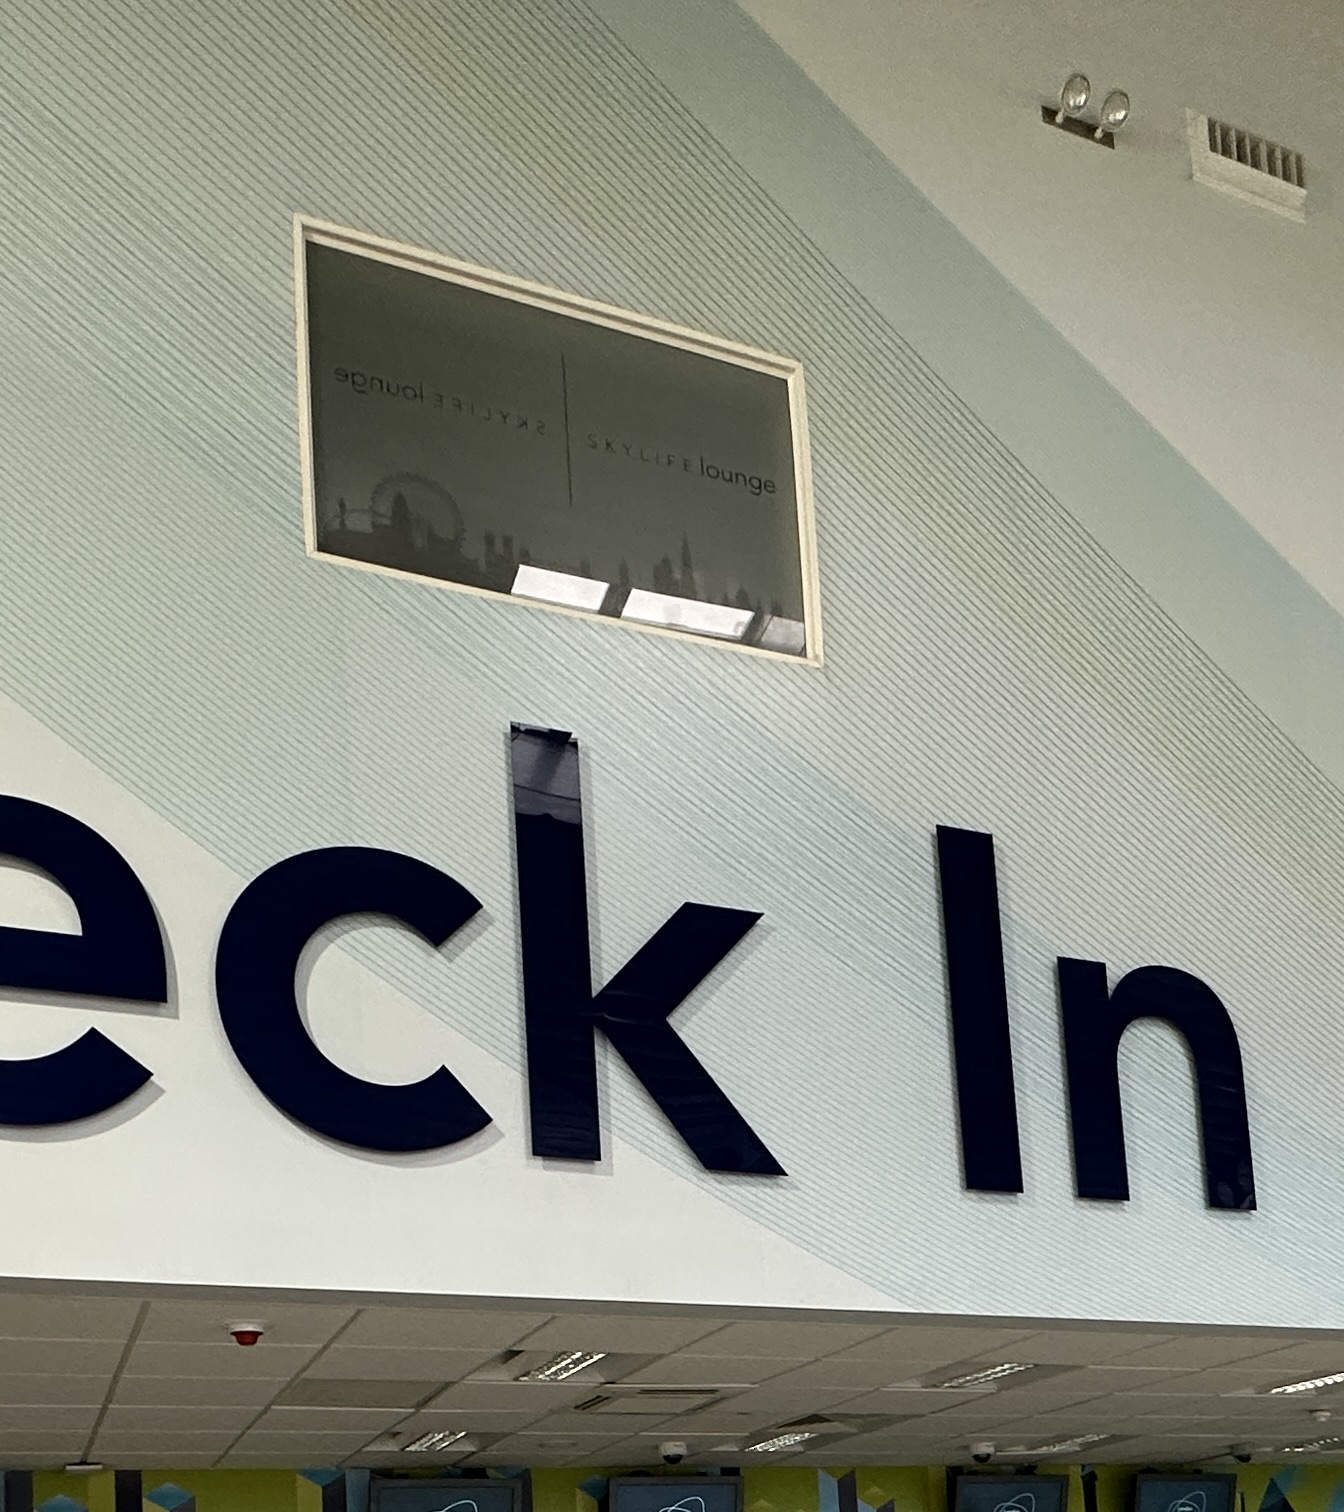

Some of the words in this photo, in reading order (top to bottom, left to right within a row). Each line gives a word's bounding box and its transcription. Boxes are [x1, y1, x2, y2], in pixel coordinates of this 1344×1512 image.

[587, 433, 692, 473] SKYLIFE
[700, 455, 777, 496] lounge
[936, 824, 1257, 1212] In
